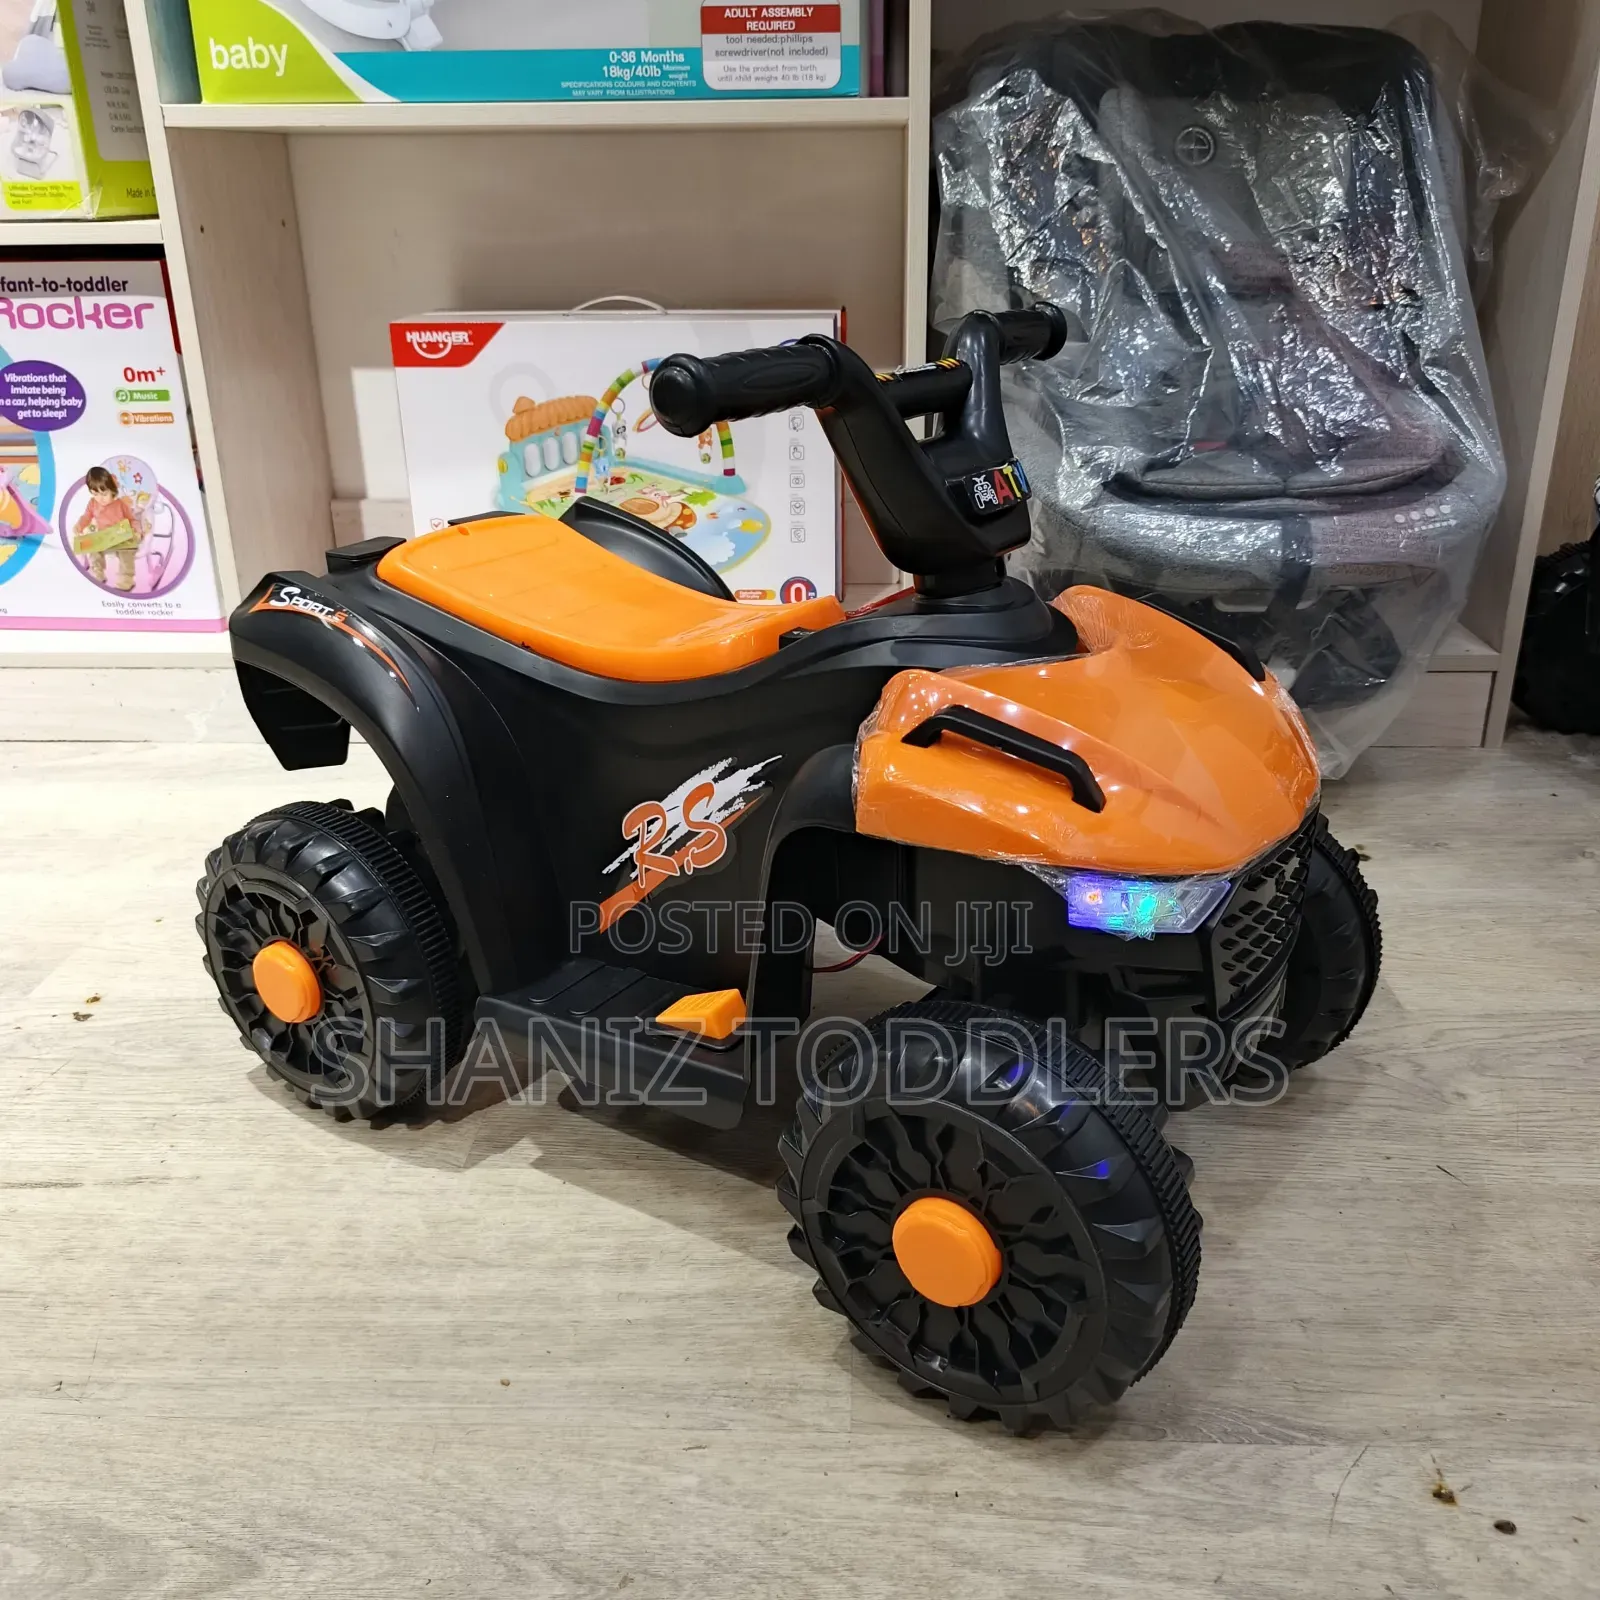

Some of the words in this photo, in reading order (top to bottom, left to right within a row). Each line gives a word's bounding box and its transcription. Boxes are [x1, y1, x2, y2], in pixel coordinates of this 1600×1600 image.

[724, 8, 757, 18] ADULT
[761, 7, 813, 17] ASSEMBLY
[746, 20, 795, 31] REQUIRED
[726, 35, 742, 43] tool
[209, 36, 288, 77] baby
[609, 51, 636, 63] 0-36
[641, 50, 685, 63] Months
[715, 48, 784, 57] screwdriver(not
[789, 47, 828, 56] included)
[603, 65, 661, 80] 18kg/40lb
[753, 65, 778, 74] product
[661, 80, 697, 88] CONTENTS
[755, 75, 778, 83] weighs
[781, 74, 790, 82] 40
[802, 74, 813, 82] (18
[816, 74, 826, 82] kg)
[126, 187, 143, 198] Made
[0, 295, 155, 330] Rocker
[405, 331, 469, 343] HUANGER
[4, 373, 48, 382] Vibrations
[49, 373, 67, 382] that
[10, 385, 41, 394] imitate
[42, 385, 66, 396] being
[133, 392, 158, 400] Music
[5, 398, 11, 406] a
[12, 398, 27, 407] car,
[28, 397, 60, 408] helping
[61, 397, 83, 408] baby
[17, 409, 32, 419] get
[32, 409, 41, 417] to
[43, 409, 67, 419] sleep!
[134, 414, 173, 422] Vibrations
